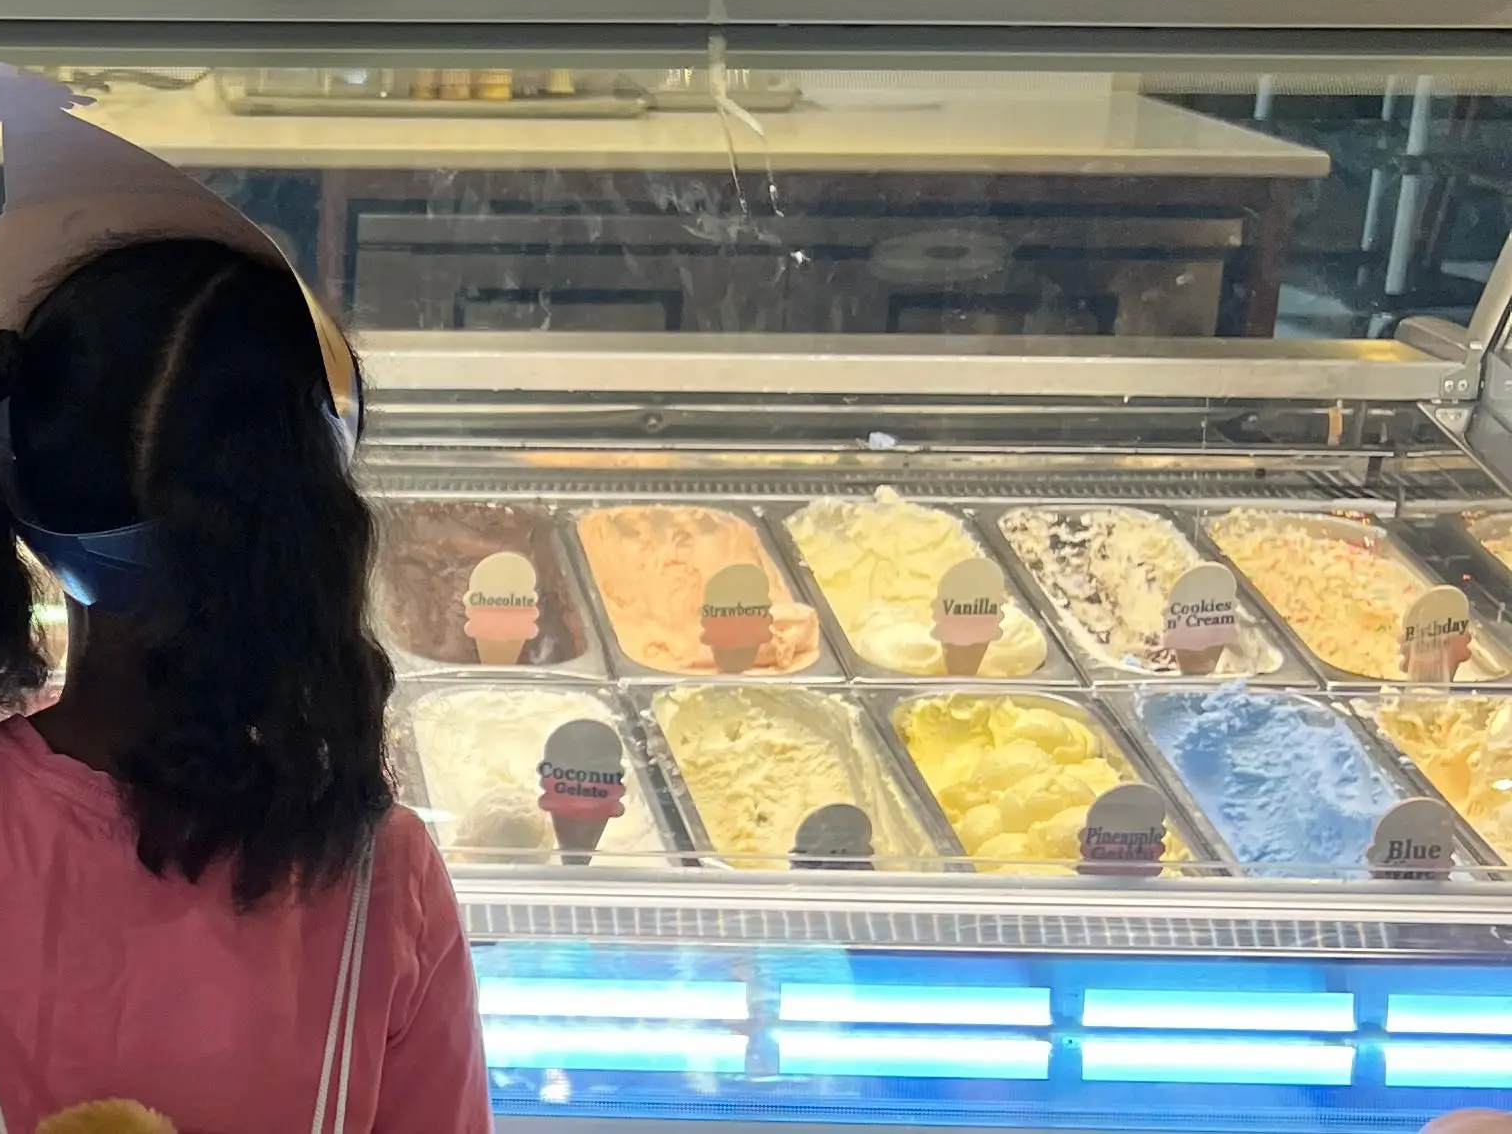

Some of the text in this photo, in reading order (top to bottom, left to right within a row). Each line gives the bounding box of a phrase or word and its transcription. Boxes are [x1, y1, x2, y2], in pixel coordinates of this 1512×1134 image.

[469, 592, 535, 608] Chocolate
[942, 597, 998, 617] Vanilla
[1170, 598, 1232, 615] Cookies
[702, 603, 768, 618] Strawberry
[1186, 614, 1235, 628] Cream
[539, 761, 624, 785] Coconut
[554, 782, 608, 799] Gelato
[1086, 827, 1163, 853] Pineapple
[1387, 839, 1441, 859] Blue
